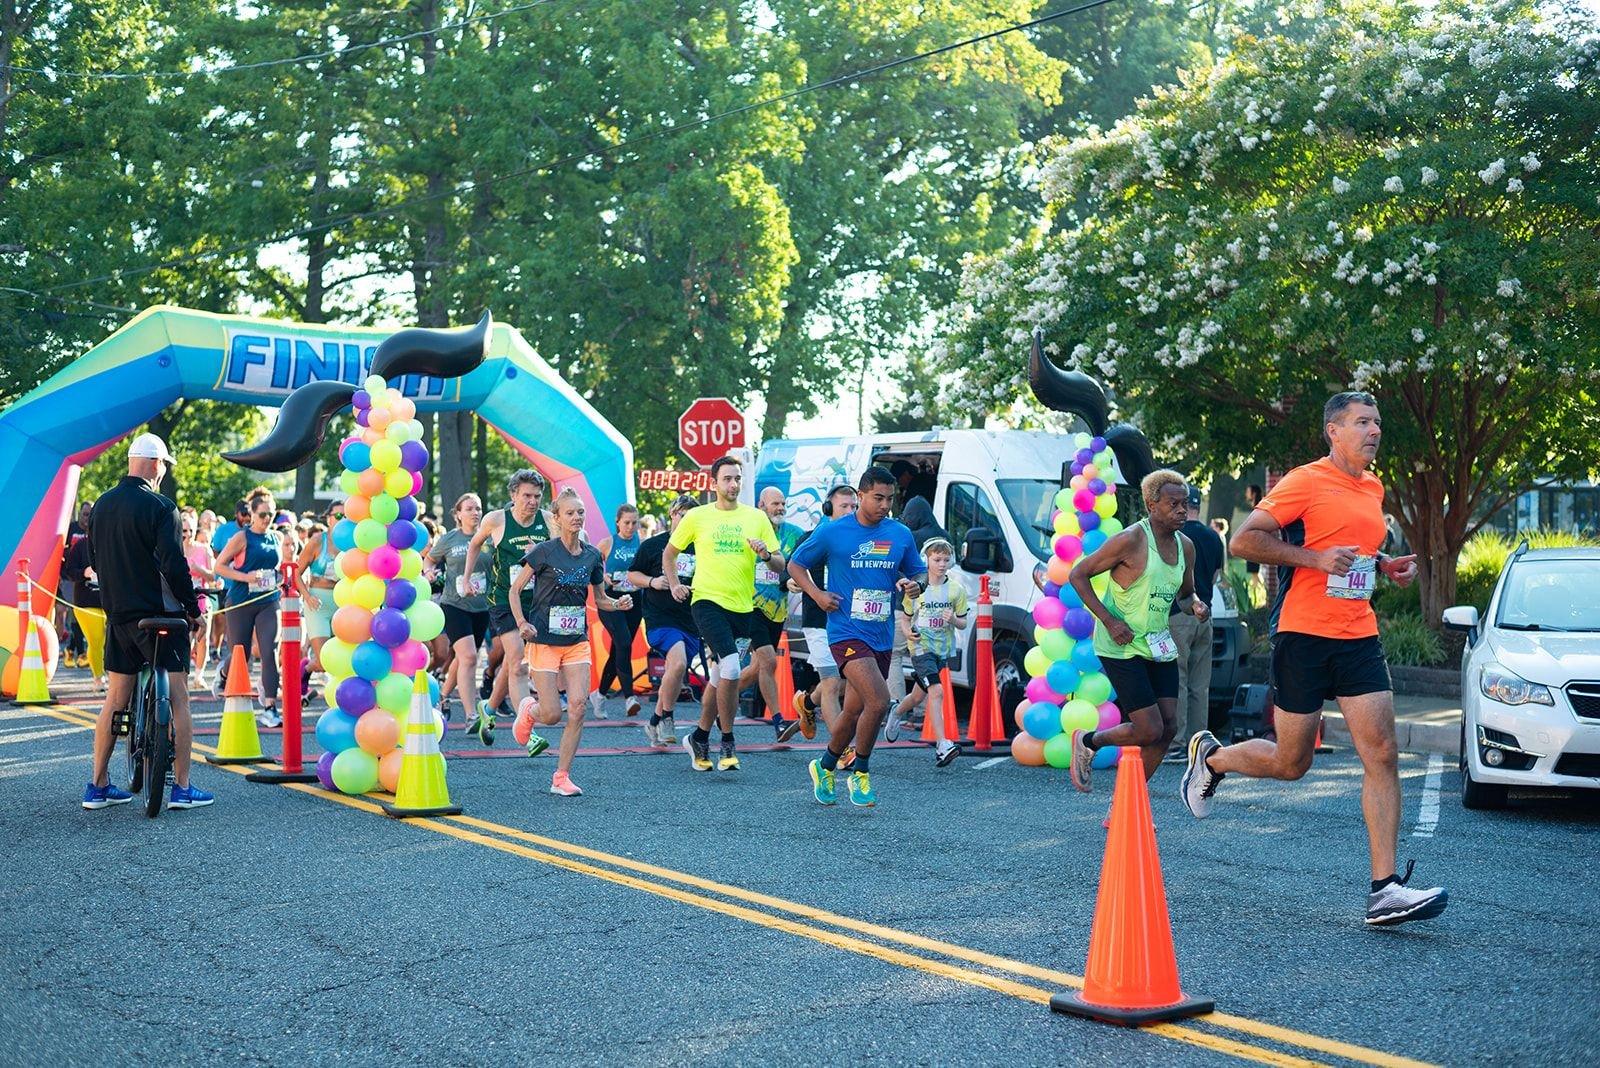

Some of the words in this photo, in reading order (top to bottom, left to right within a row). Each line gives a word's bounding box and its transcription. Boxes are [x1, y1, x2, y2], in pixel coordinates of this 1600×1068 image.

[227, 335, 446, 397] FINI
[684, 420, 741, 446] STOP
[851, 560, 863, 569] RUN
[865, 560, 895, 569] NEWPORT
[1347, 572, 1367, 589] 144
[863, 601, 883, 614] 307
[920, 601, 953, 610] Falcons
[560, 617, 578, 629] 322
[929, 617, 945, 628] 190
